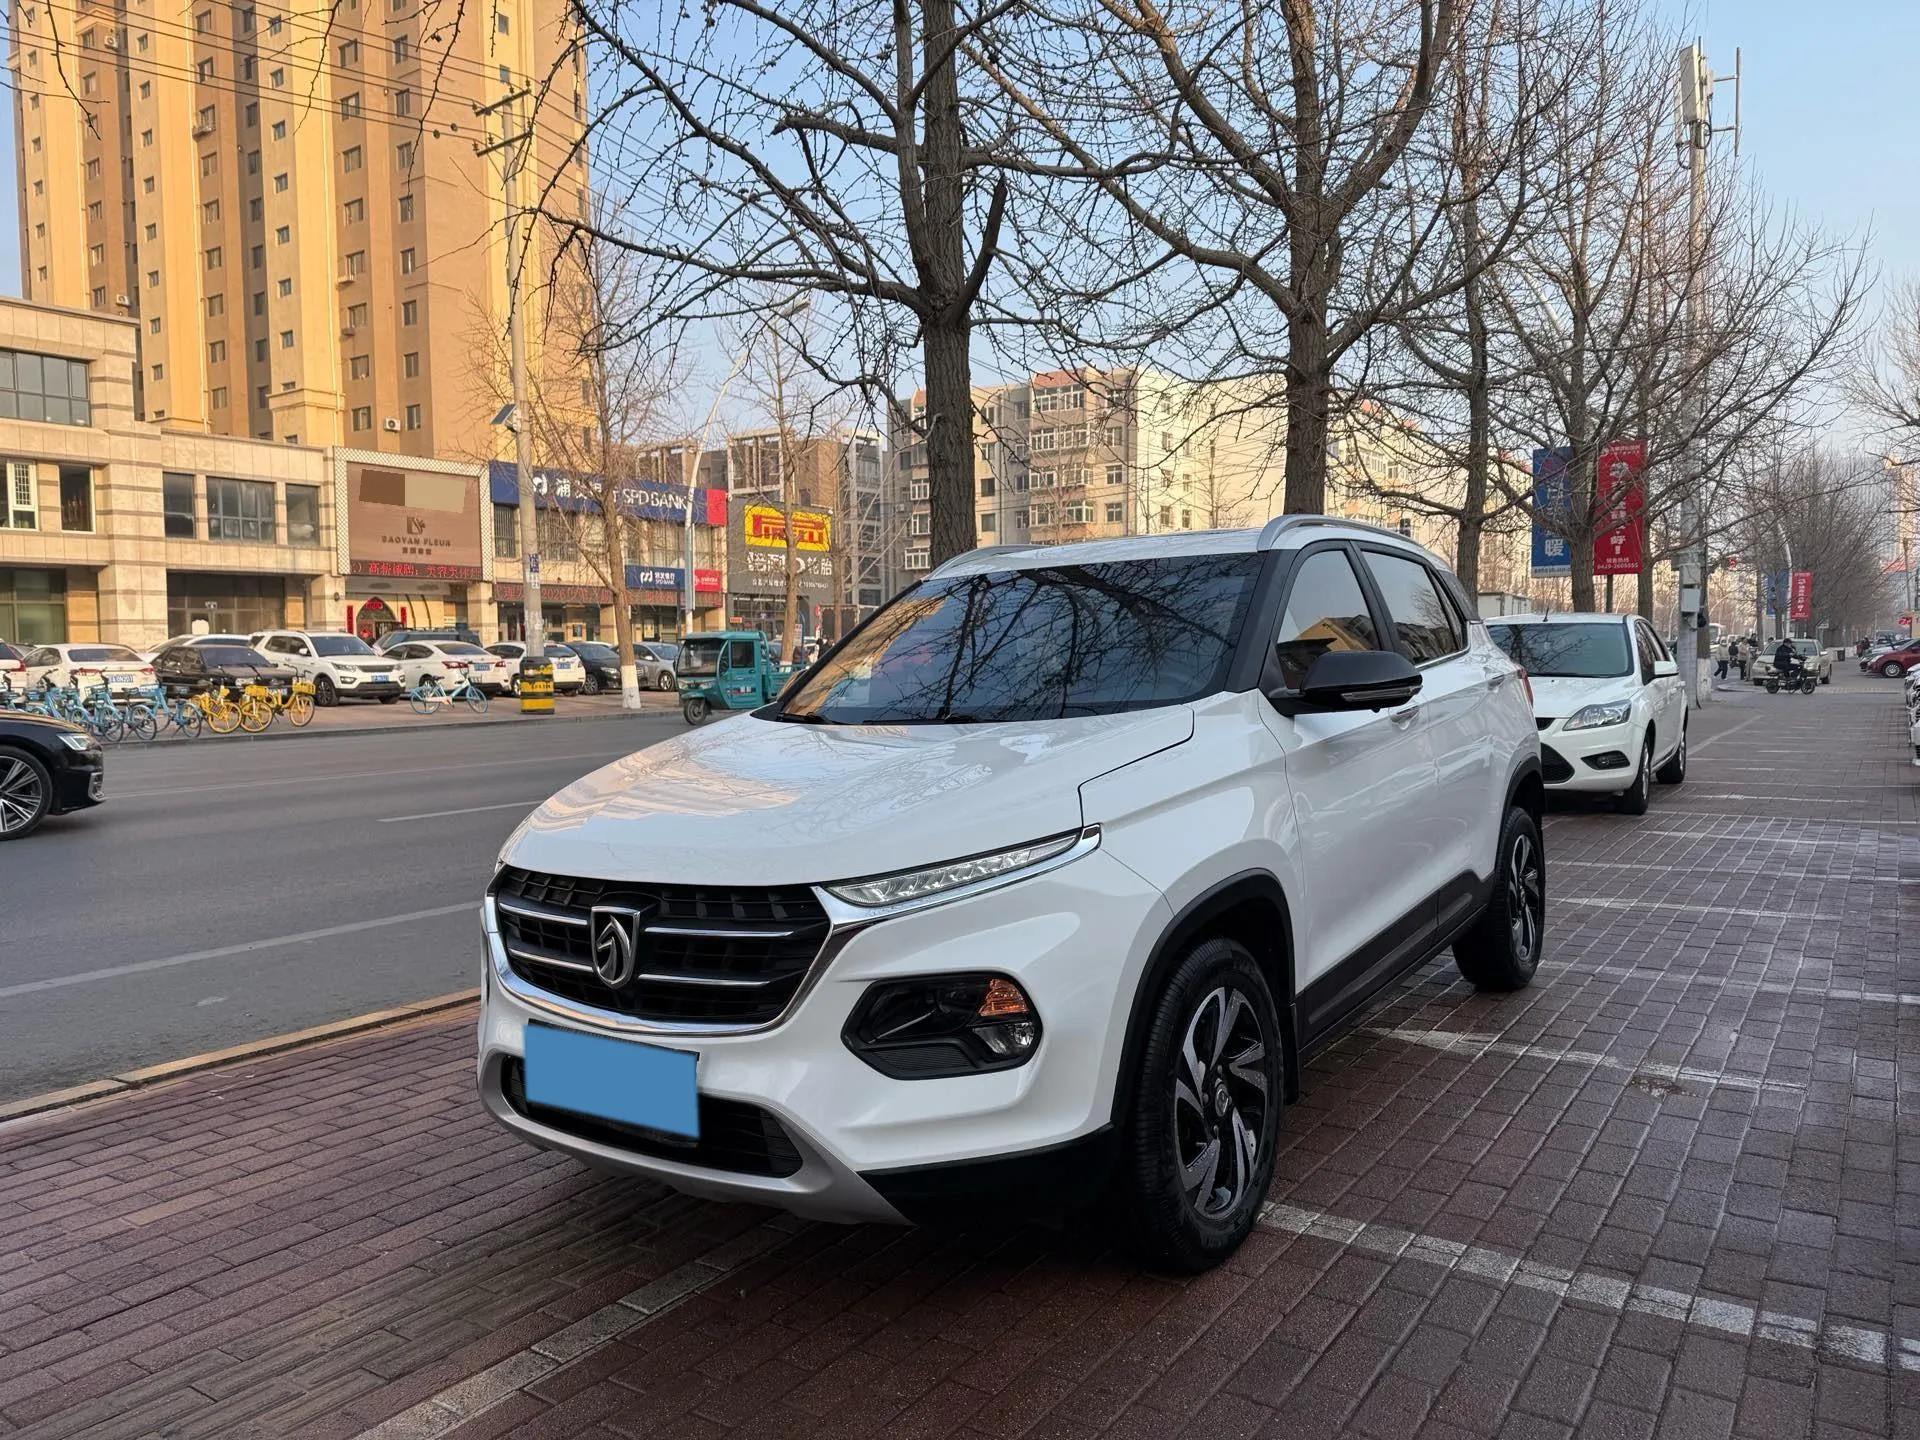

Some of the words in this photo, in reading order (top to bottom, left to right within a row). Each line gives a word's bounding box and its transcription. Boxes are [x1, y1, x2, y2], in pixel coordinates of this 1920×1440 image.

[622, 488, 649, 504] SPD
[650, 492, 687, 510] BANK
[752, 513, 824, 544] PIRLLI
